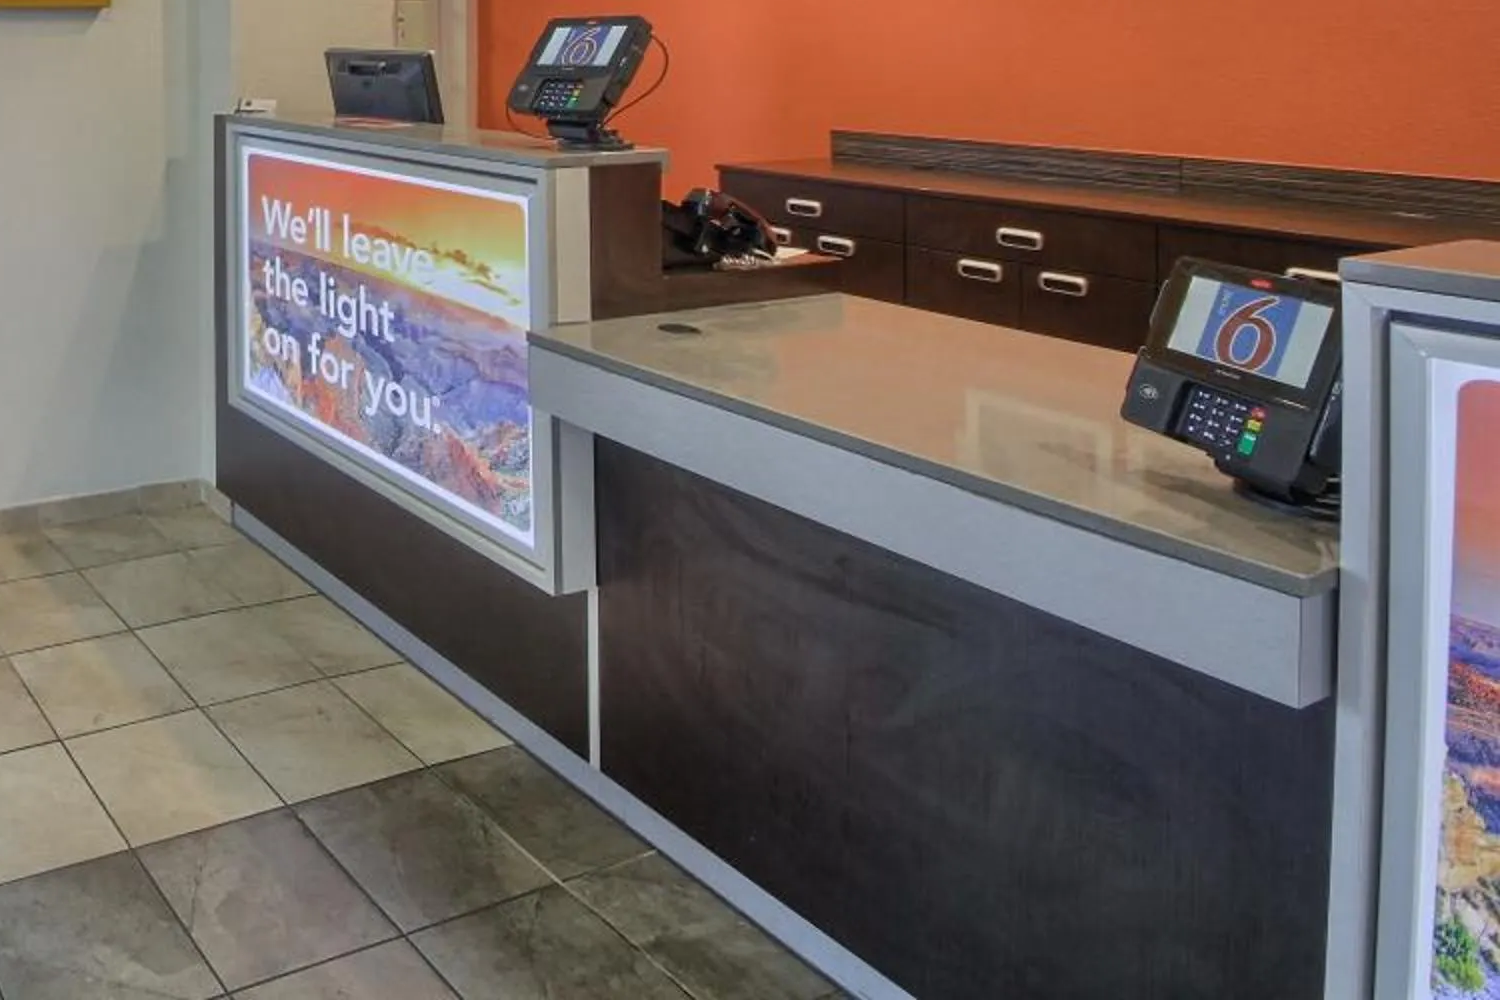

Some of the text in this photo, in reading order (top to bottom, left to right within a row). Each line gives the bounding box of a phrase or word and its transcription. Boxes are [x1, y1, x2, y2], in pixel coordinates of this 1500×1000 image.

[260, 194, 435, 277] We'll leave
[263, 257, 395, 344] the light
[1214, 295, 1279, 372] 6
[263, 326, 299, 364] on
[308, 332, 354, 390] for
